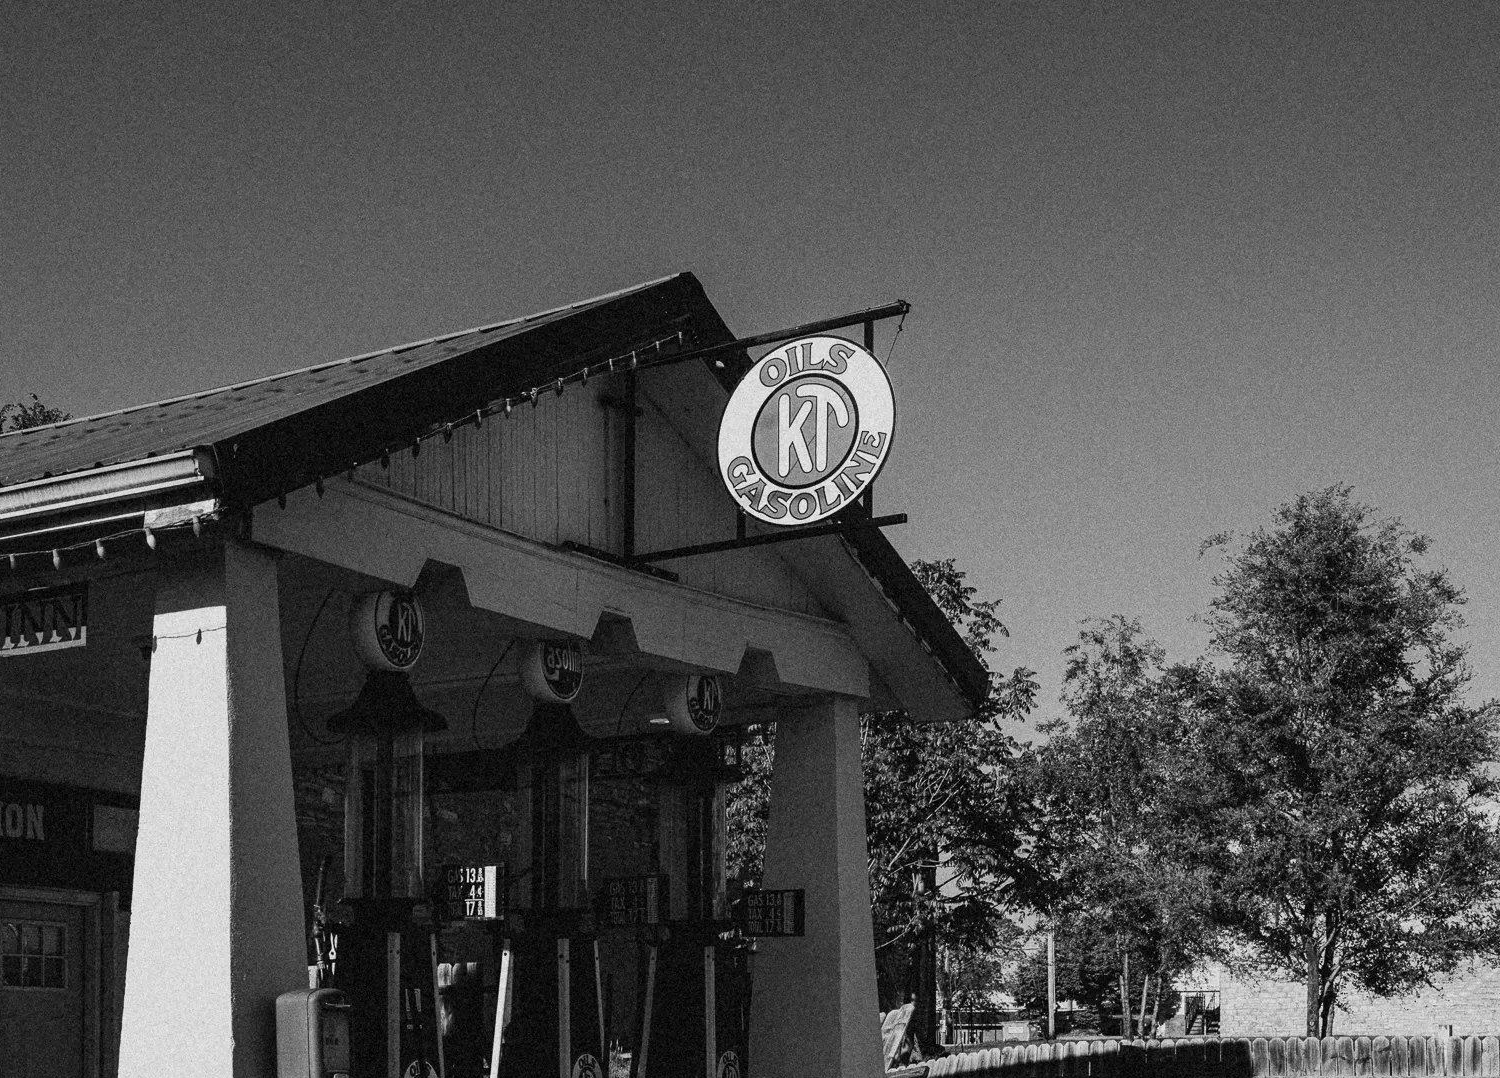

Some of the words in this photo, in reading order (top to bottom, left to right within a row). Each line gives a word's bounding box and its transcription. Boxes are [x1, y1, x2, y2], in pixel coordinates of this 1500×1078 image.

[759, 342, 856, 387] OILS
[777, 383, 849, 478] KT
[727, 430, 887, 520] GASOLINE
[1, 596, 82, 650] INN
